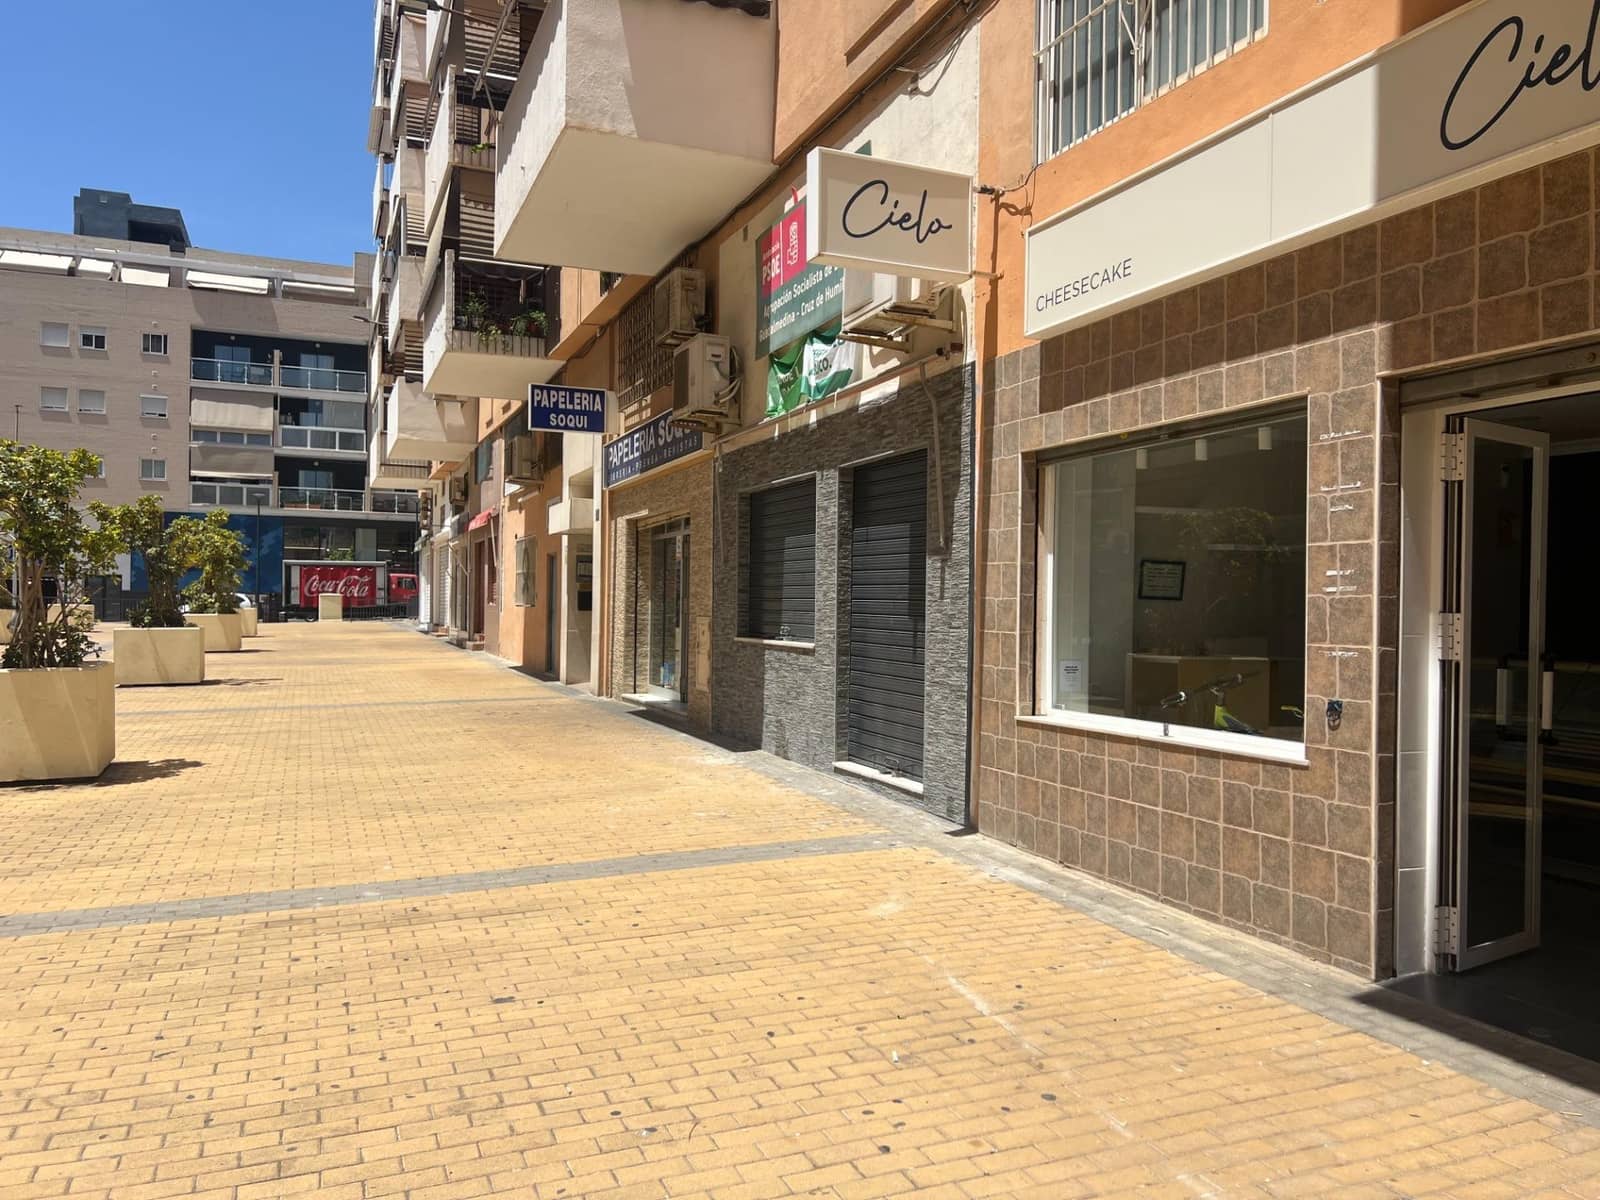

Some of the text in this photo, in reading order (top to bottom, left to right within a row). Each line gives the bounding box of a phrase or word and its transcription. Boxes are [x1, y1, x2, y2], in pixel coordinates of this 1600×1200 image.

[1440, 0, 1600, 150] Ciel
[842, 179, 953, 244] Cielo
[793, 269, 823, 298] Socialista
[801, 299, 815, 316] Cruz
[816, 290, 824, 307] de
[825, 277, 844, 301] Humi
[1036, 257, 1133, 312] CHEESECAKE
[533, 388, 602, 412] PAPELERIA
[549, 413, 588, 428] SOQUI
[608, 415, 691, 470] PAPELERIA SOQ
[304, 574, 371, 598] Coca-Cola
